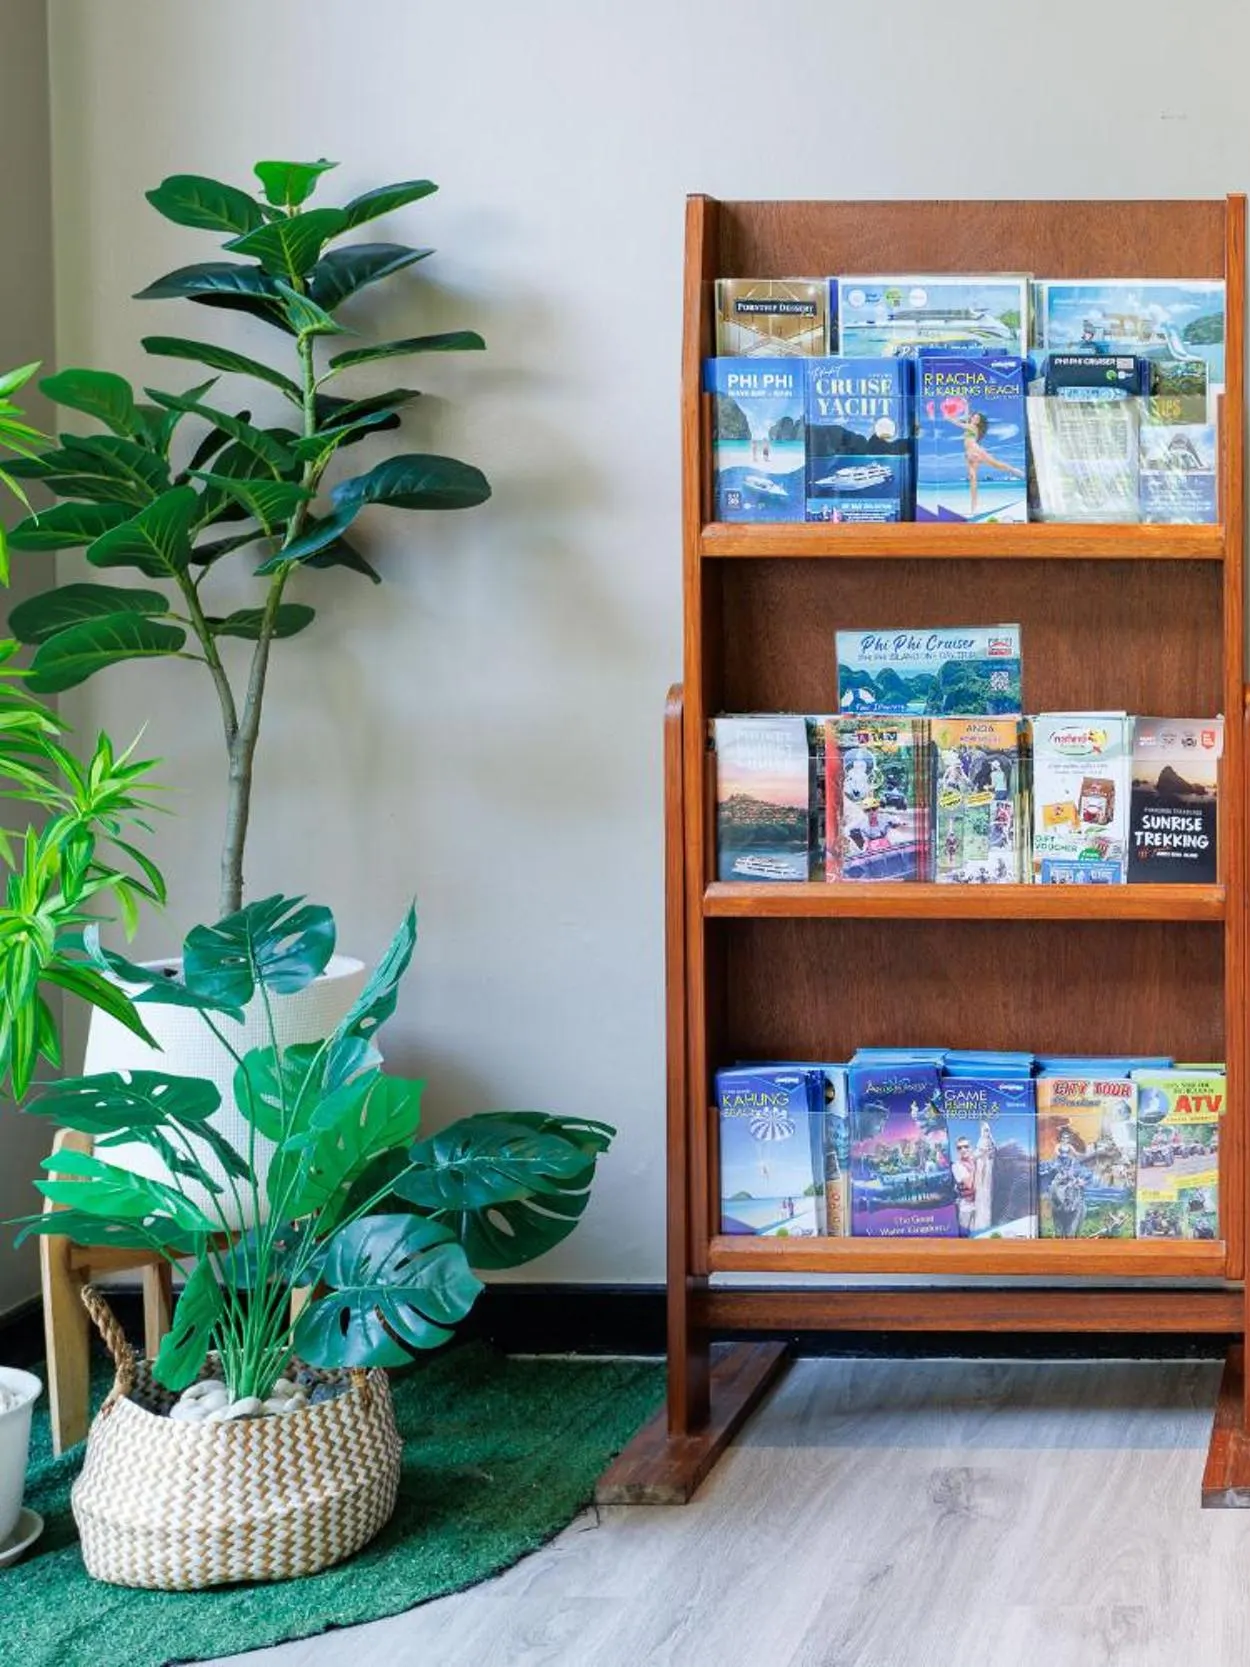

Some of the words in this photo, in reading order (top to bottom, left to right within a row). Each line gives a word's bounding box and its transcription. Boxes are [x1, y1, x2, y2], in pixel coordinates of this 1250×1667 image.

[727, 374, 758, 389] PHI
[763, 374, 793, 389] PHI
[815, 378, 893, 395] CRUISE
[817, 398, 893, 416] YACHT
[860, 634, 890, 654] Phi
[893, 634, 921, 653] Phi
[925, 634, 977, 652] Cruiser
[1141, 814, 1203, 831] SUNRISE
[1134, 831, 1210, 849] TREKKING
[943, 1089, 988, 1101] GAME
[1093, 1081, 1133, 1098] TOUR
[943, 1100, 988, 1110] FISHING
[1173, 1094, 1223, 1113] ATV
